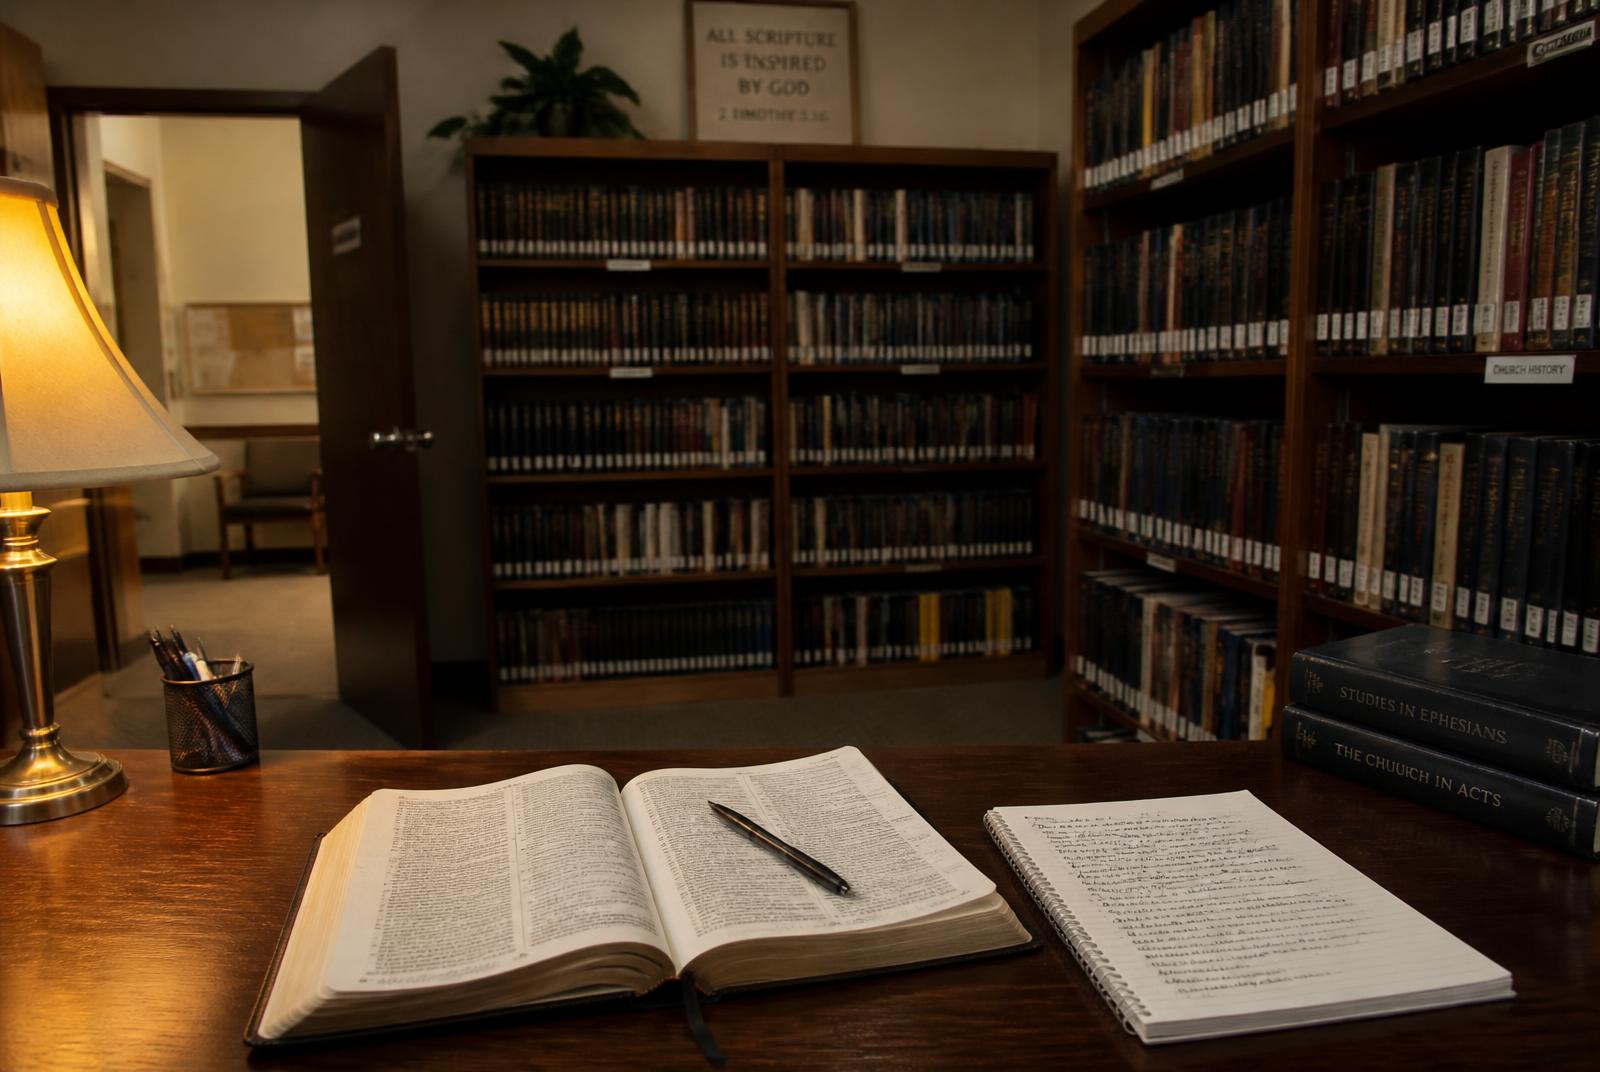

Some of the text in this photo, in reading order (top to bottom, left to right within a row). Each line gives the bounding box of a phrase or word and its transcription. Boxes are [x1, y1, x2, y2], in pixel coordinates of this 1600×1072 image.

[706, 28, 837, 48] ALL SCRIPTURE
[721, 53, 827, 72] IS INSPIRED
[738, 78, 811, 96] BY GOD
[1528, 364, 1567, 376] HISTORY
[1340, 686, 1508, 744] STUDIES IN EPHESIANS
[1335, 742, 1362, 763] THE
[1435, 775, 1453, 792] IN
[1457, 783, 1502, 808] ACTS
